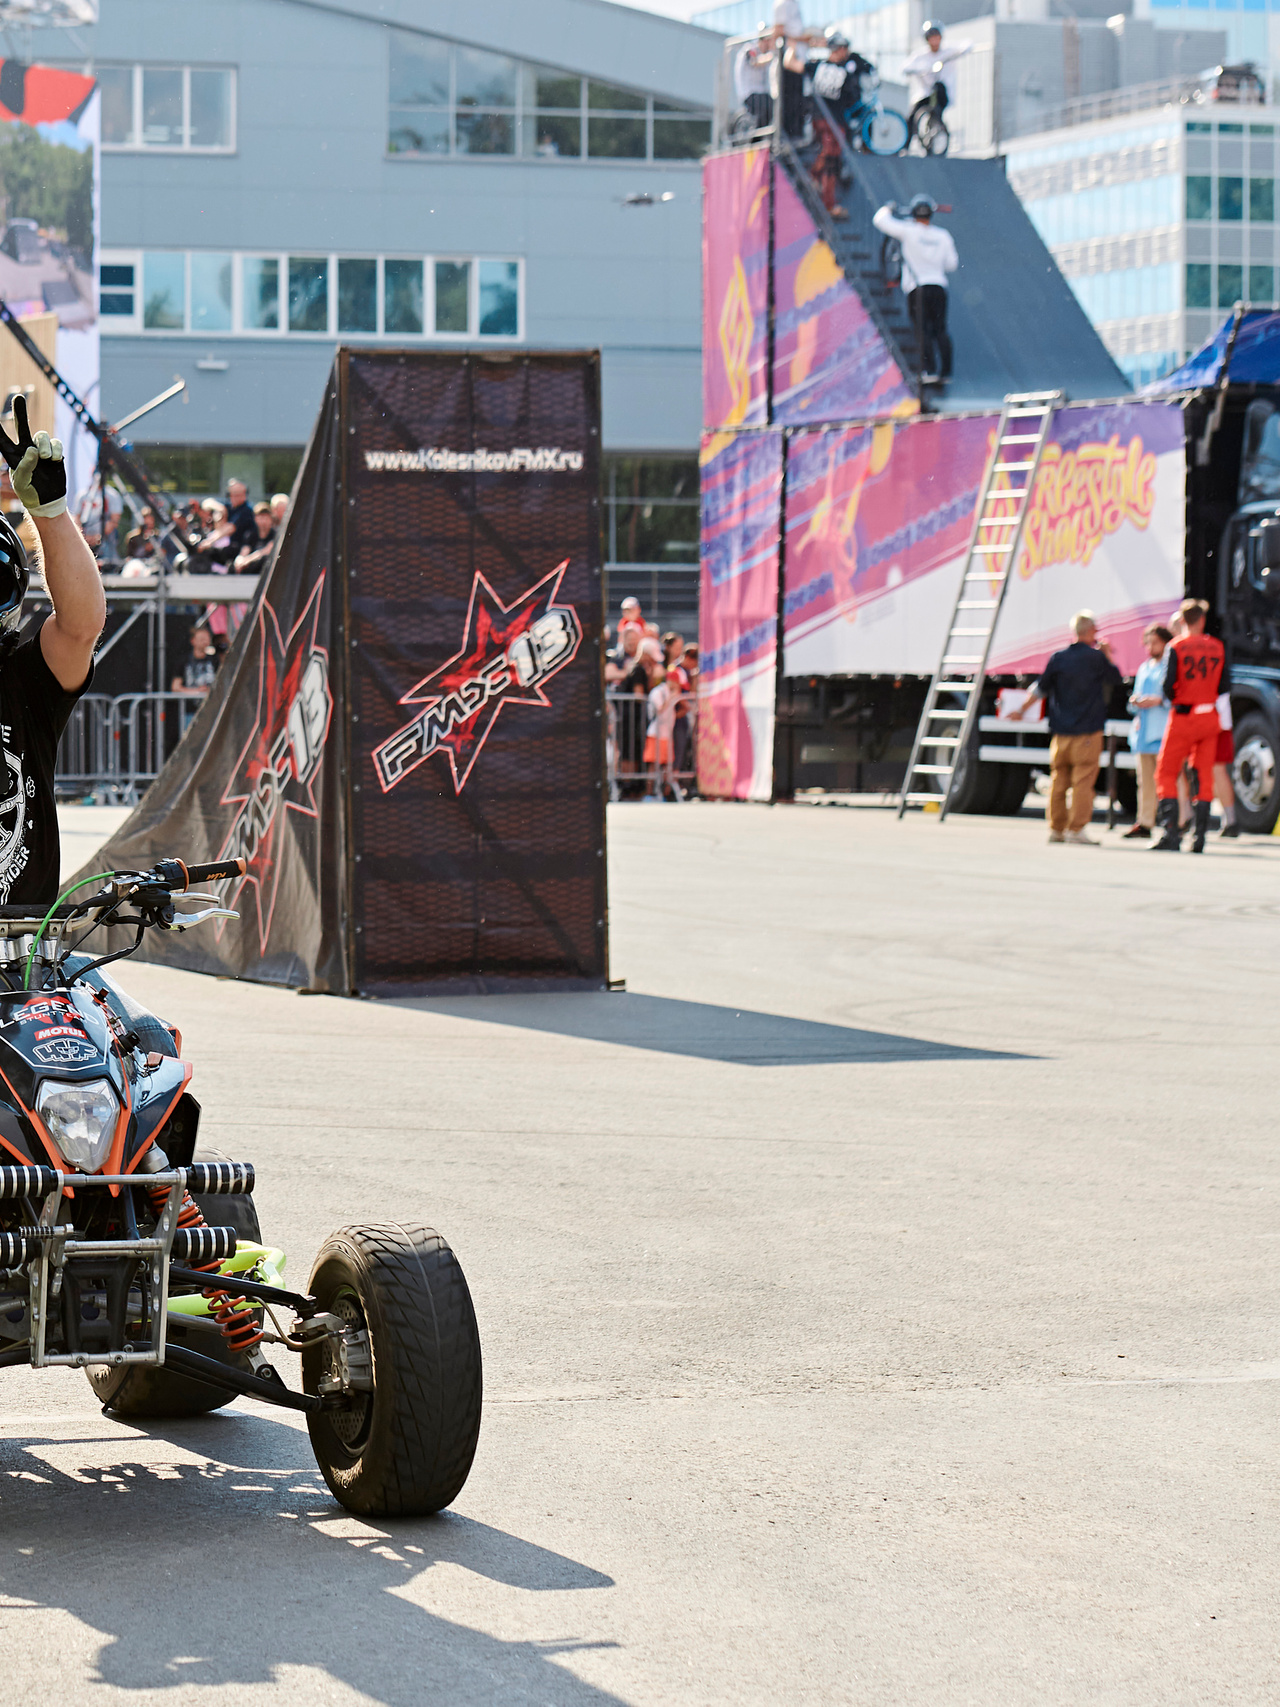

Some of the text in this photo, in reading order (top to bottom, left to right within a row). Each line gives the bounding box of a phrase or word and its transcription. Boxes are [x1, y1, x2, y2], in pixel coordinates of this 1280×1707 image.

[365, 447, 584, 472] www.KolesnikovFMX.ru
[1183, 656, 1220, 679] 247
[38, 1026, 85, 1040] MOTUL
